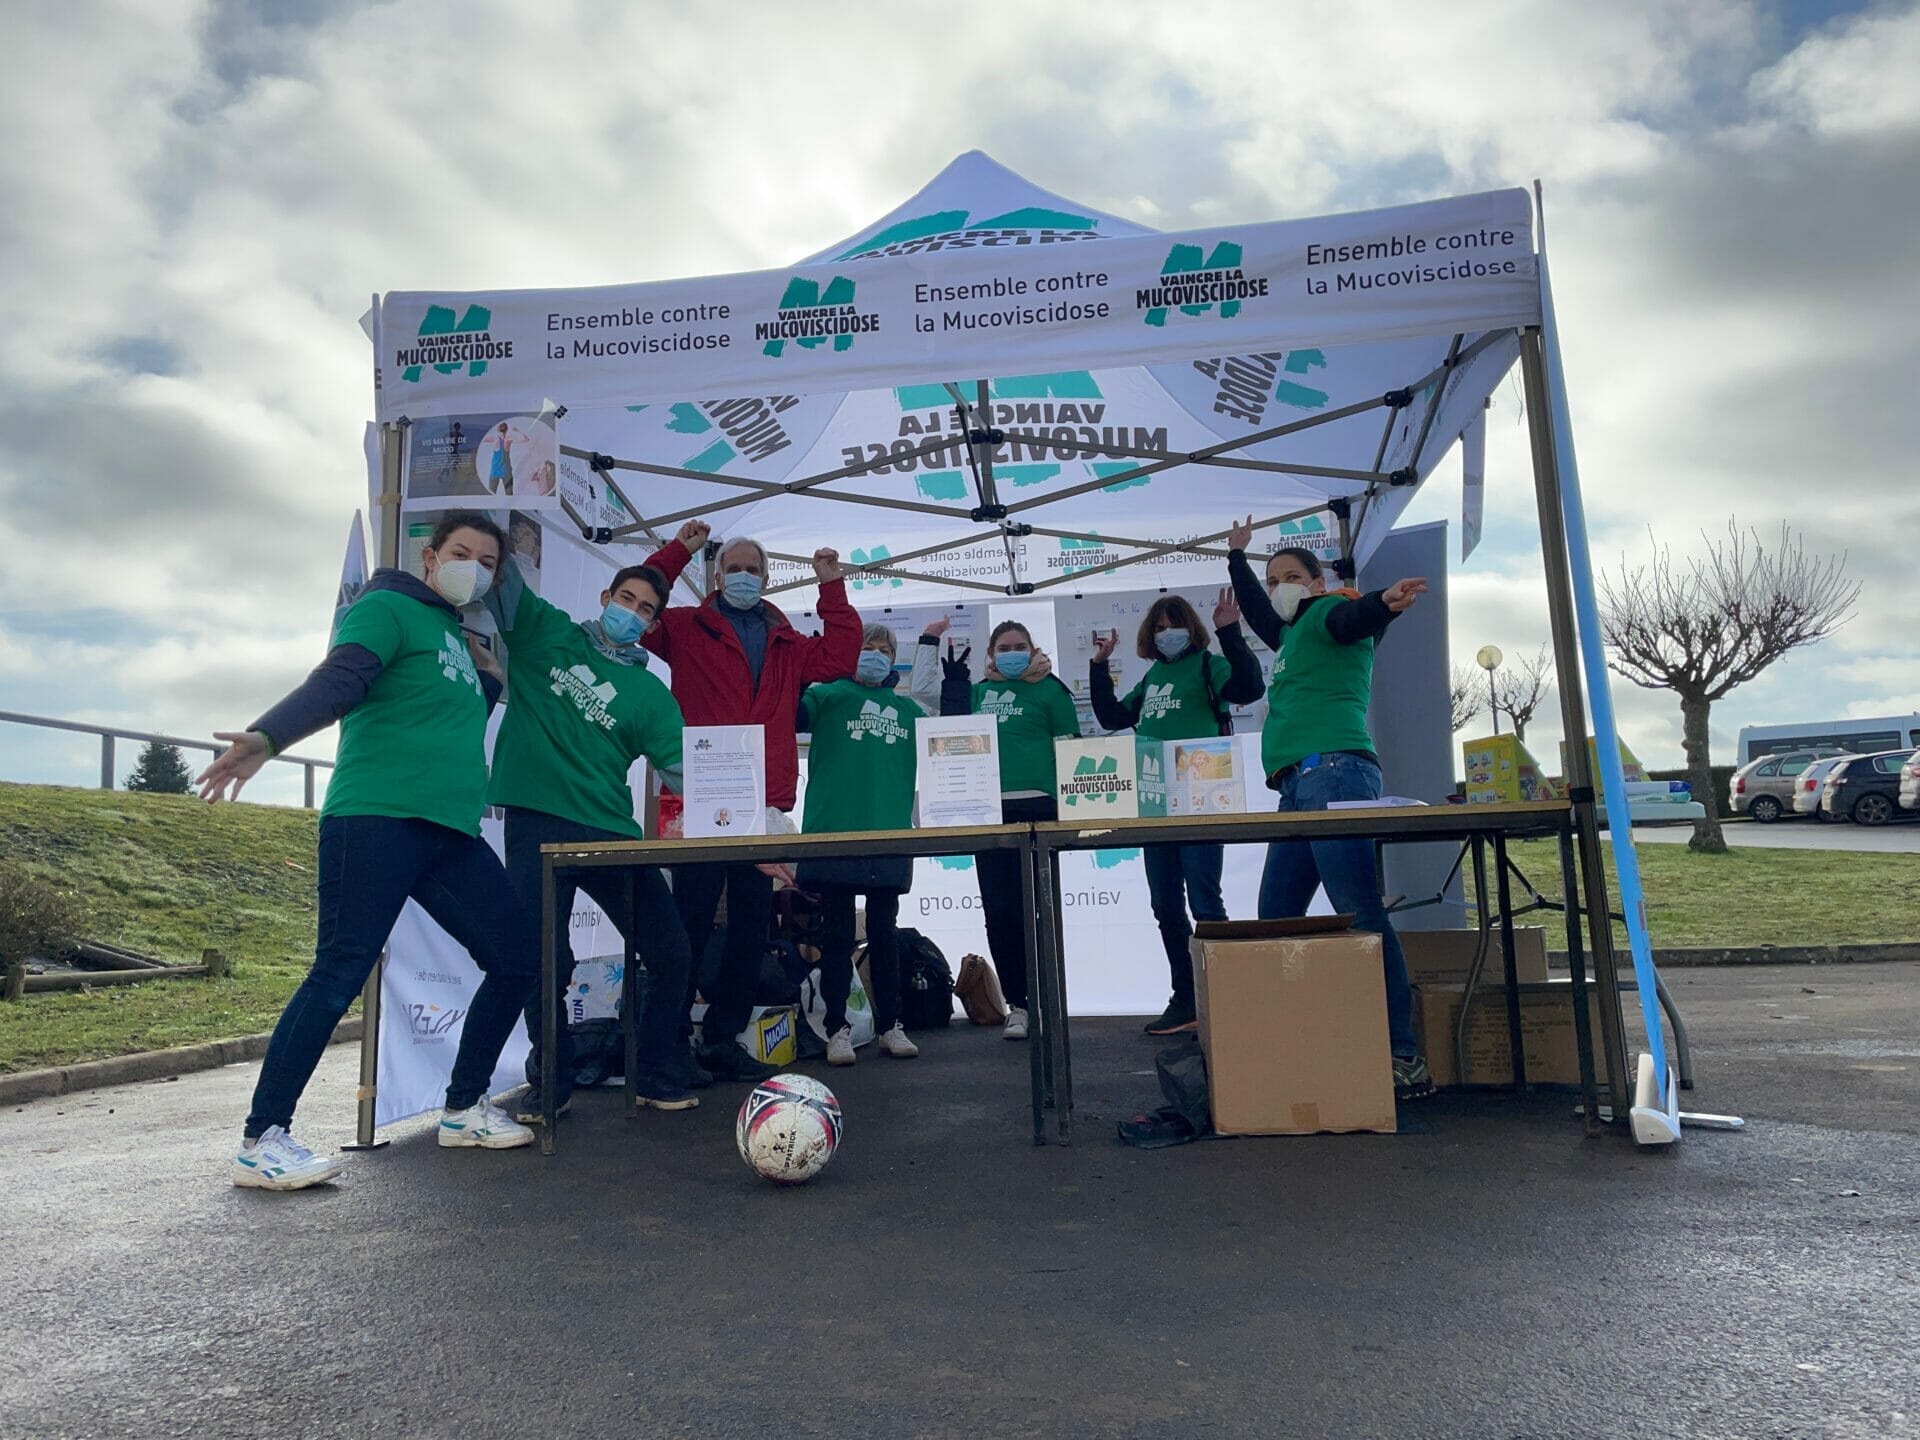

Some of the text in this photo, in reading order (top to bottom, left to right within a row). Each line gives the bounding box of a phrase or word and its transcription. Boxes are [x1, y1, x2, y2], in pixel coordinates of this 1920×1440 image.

[1307, 229, 1514, 265] Ensemble contre
[915, 271, 1108, 303] Ensemble contre
[1160, 269, 1244, 287] VAINCRE LA
[1307, 260, 1516, 295] la Mucoviscidose
[1136, 279, 1268, 309] MUCOVISCIDOSE
[547, 303, 730, 331] Ensemble contre
[778, 306, 857, 321] VAINCRE LA
[915, 301, 1109, 332] la Mucoviscidose
[417, 332, 491, 347] VAINCRE LA
[755, 314, 879, 341] MUCOVISCIDOSE
[396, 341, 513, 367] MUCOVISCIDOSE
[547, 332, 730, 359] la Mucoviscidose
[1060, 779, 1132, 795] MUCOVISCIDOSE
[1073, 773, 1118, 783] VAINCRE LA
[765, 1014, 789, 1054] MAOAM
[786, 1130, 797, 1162] PATRICK
